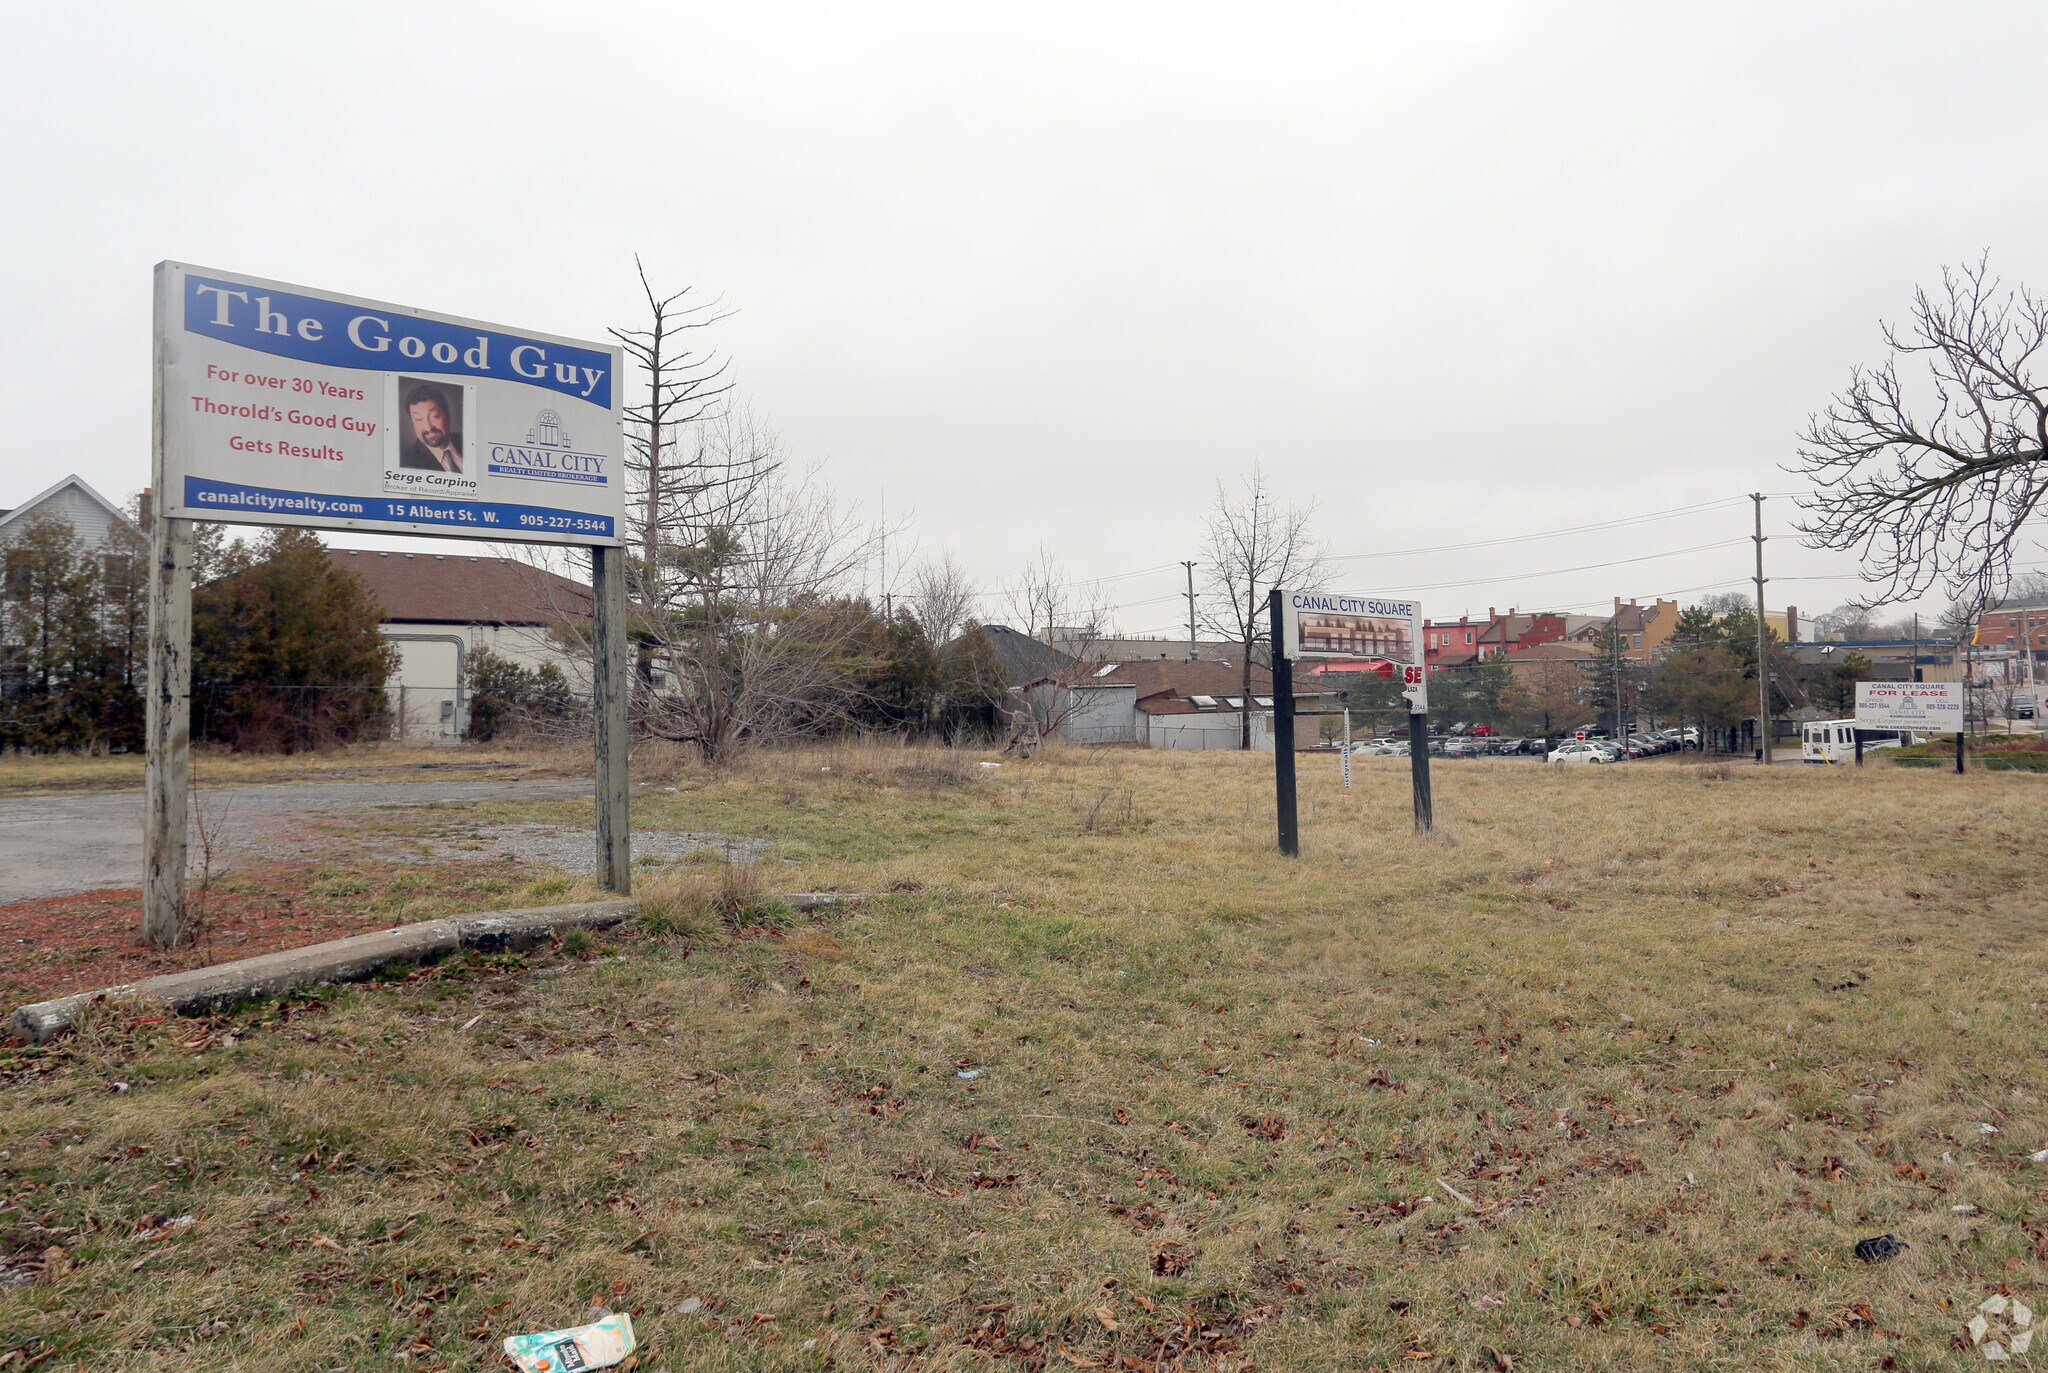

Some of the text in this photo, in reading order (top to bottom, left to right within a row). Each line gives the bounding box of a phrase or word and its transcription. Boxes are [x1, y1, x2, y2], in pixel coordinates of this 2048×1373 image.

[196, 283, 605, 396] The Good Guy
[207, 364, 364, 400] For over 30 Years
[287, 410, 336, 428] Good
[342, 417, 376, 436] Guy
[229, 436, 344, 461] Gets Results
[491, 446, 605, 473] CANAL CITY
[384, 470, 477, 489] Serge Carpino
[499, 466, 598, 482] REALTY LIMITED BROKERAGE
[418, 486, 478, 498] Record/Appraiser
[197, 490, 607, 531] canalcityrealty.com 15 Albert St. W. 905-227-5544
[1292, 595, 1413, 616] CANAL CITY SQUARE
[1404, 666, 1422, 684] SE
[560, 1344, 575, 1369] Minute
[567, 1344, 581, 1362] Maid
